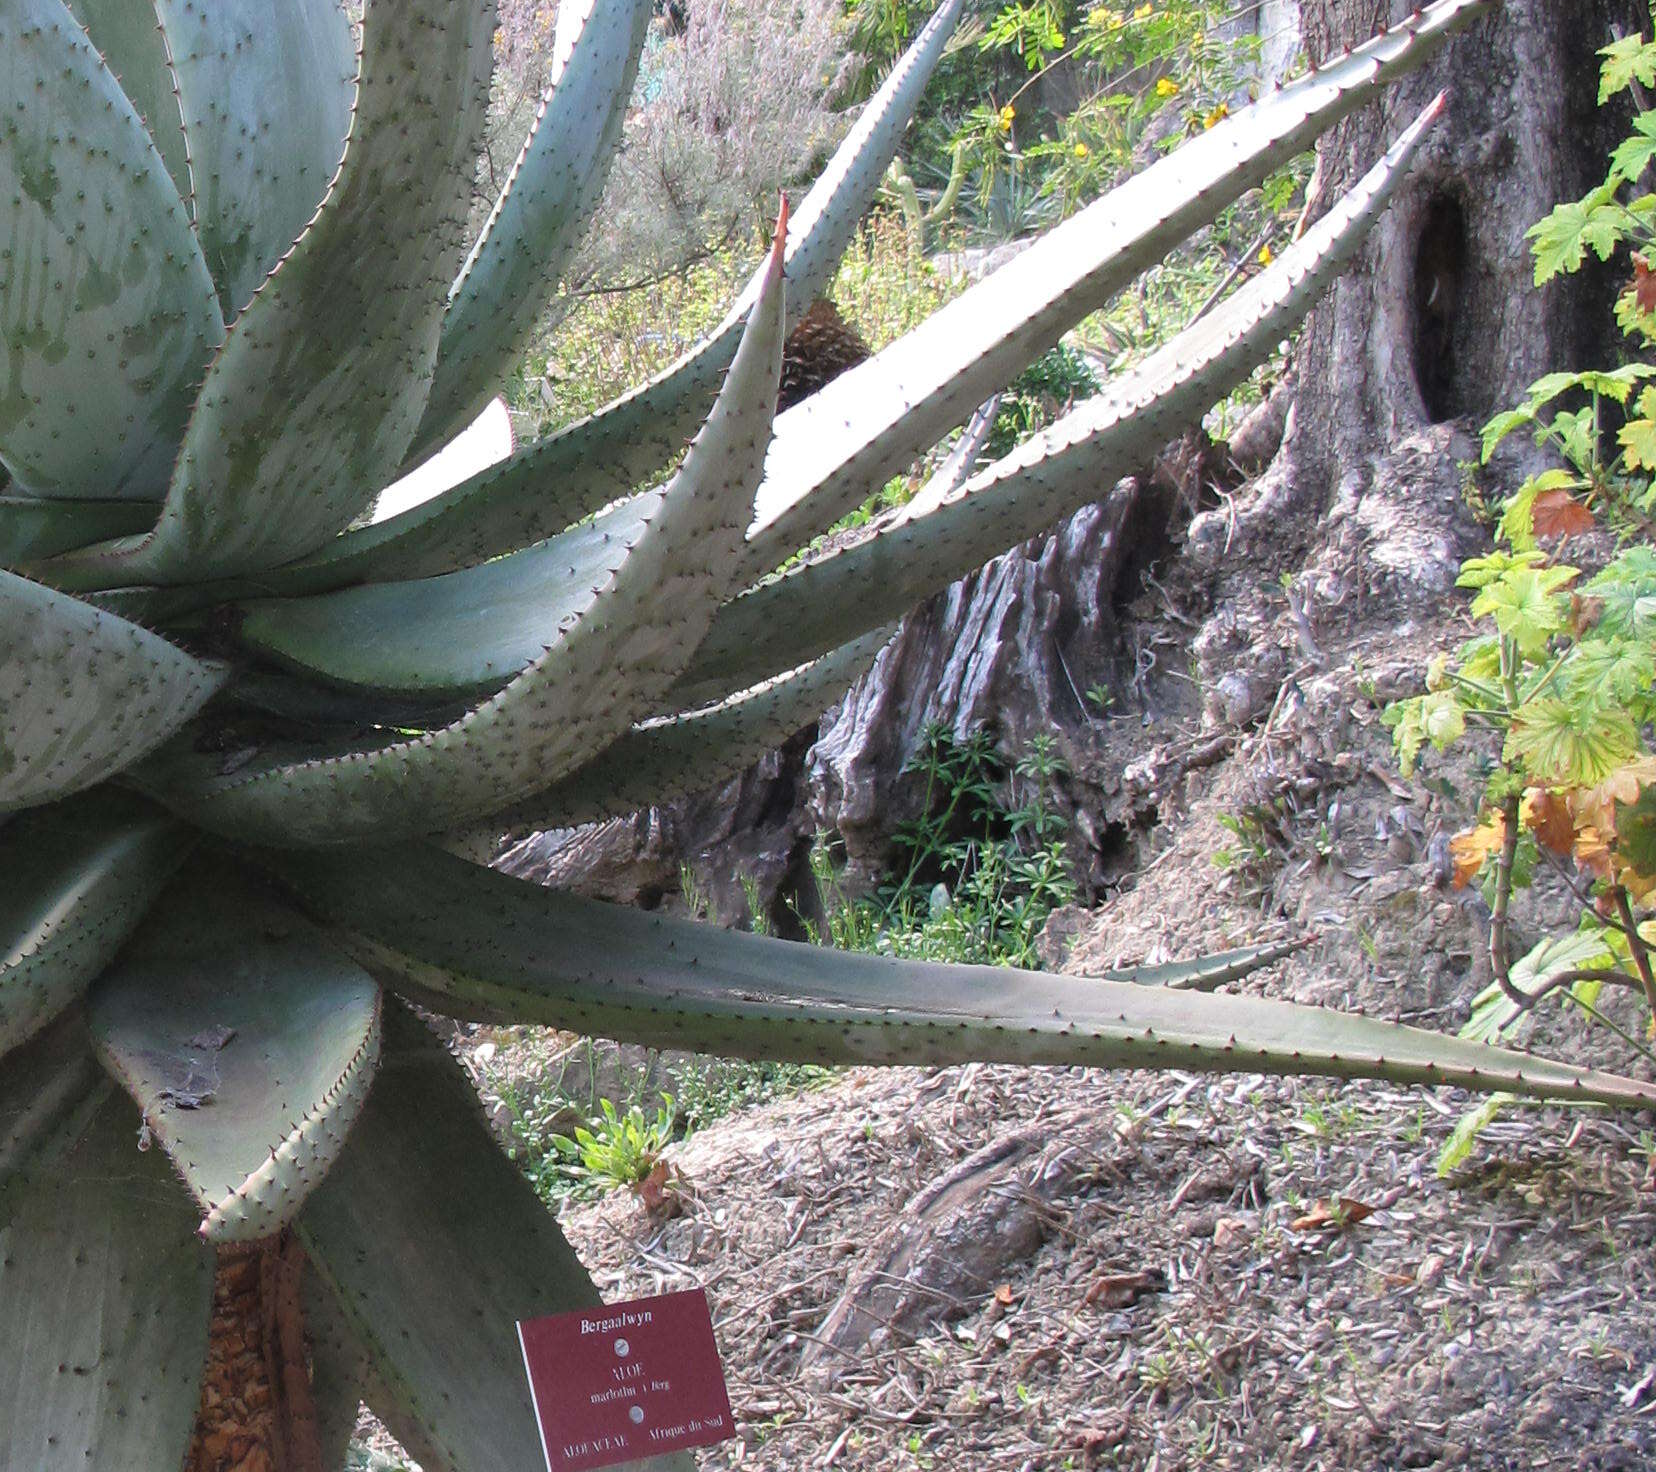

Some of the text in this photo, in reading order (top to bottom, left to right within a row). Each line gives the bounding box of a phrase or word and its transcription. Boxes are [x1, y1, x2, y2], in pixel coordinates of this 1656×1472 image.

[581, 1311, 652, 1334] Bergaalwyn
[649, 1415, 723, 1441] Afrique du Sud
